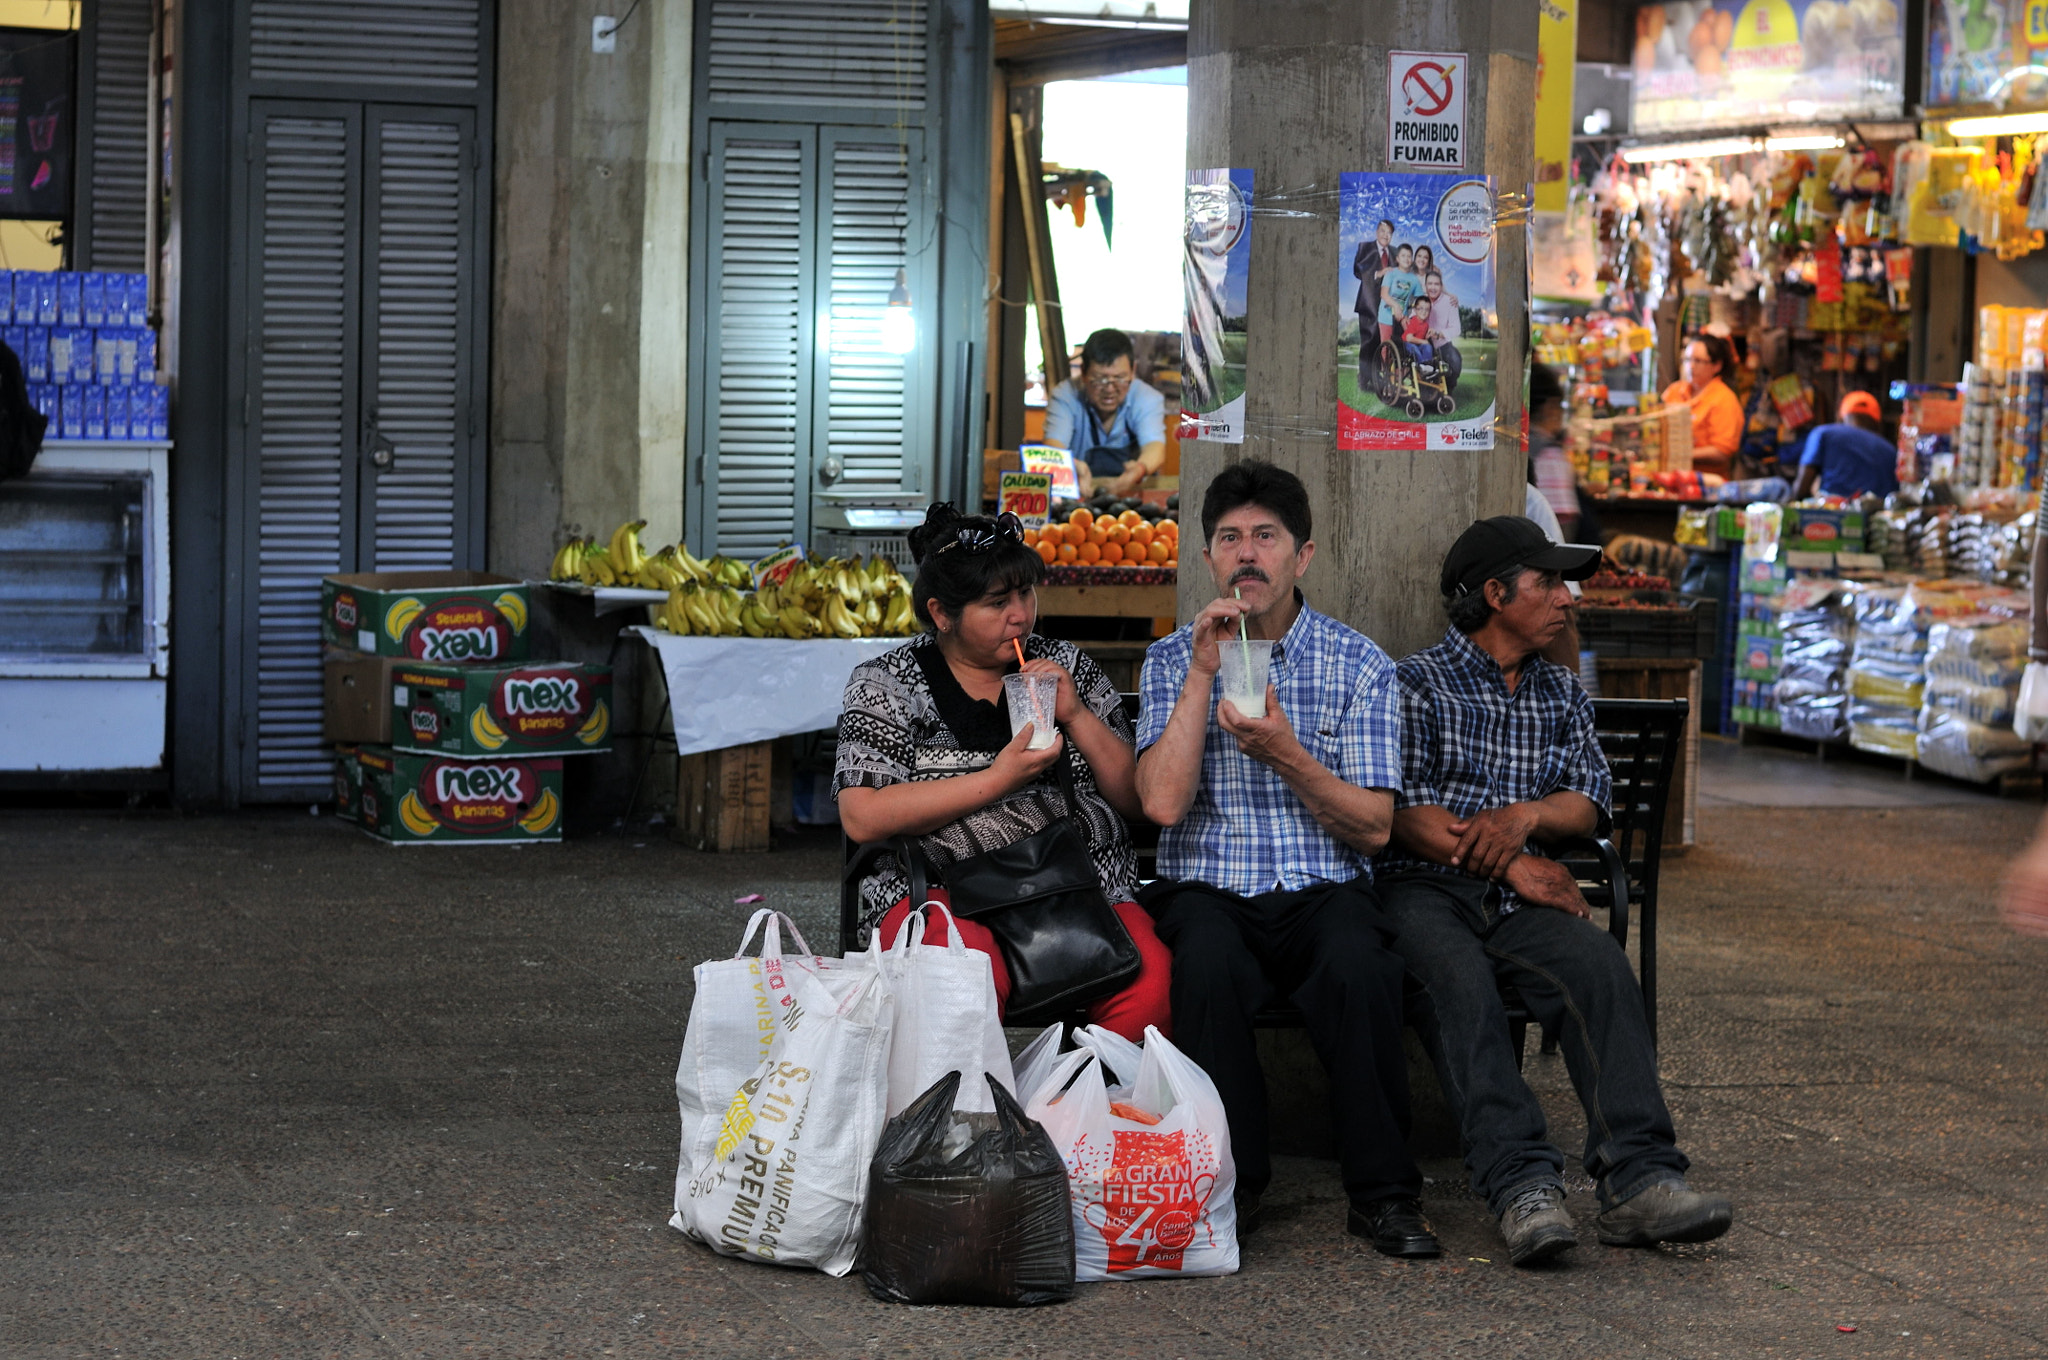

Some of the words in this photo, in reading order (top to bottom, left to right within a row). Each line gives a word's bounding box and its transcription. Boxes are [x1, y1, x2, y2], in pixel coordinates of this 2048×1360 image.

[1394, 121, 1459, 143] PROHIBIDO
[1394, 146, 1458, 163] FUMAR
[1448, 200, 1479, 208] Cuando
[1354, 431, 1385, 439] ABRAZO
[1387, 431, 1396, 439] DE
[1003, 475, 1047, 488] CALIDAD
[1004, 492, 1047, 516] 700
[420, 626, 498, 660] nex
[504, 677, 581, 715] nex
[436, 765, 521, 802] nex
[1106, 1172, 1124, 1183] LA
[1126, 1164, 1190, 1183] GRAN
[1106, 1183, 1195, 1205] FIESTA
[1120, 1206, 1136, 1216] DE
[1107, 1218, 1128, 1227] LOS
[1162, 1221, 1190, 1230] Santa
[1153, 1252, 1181, 1262] Años
